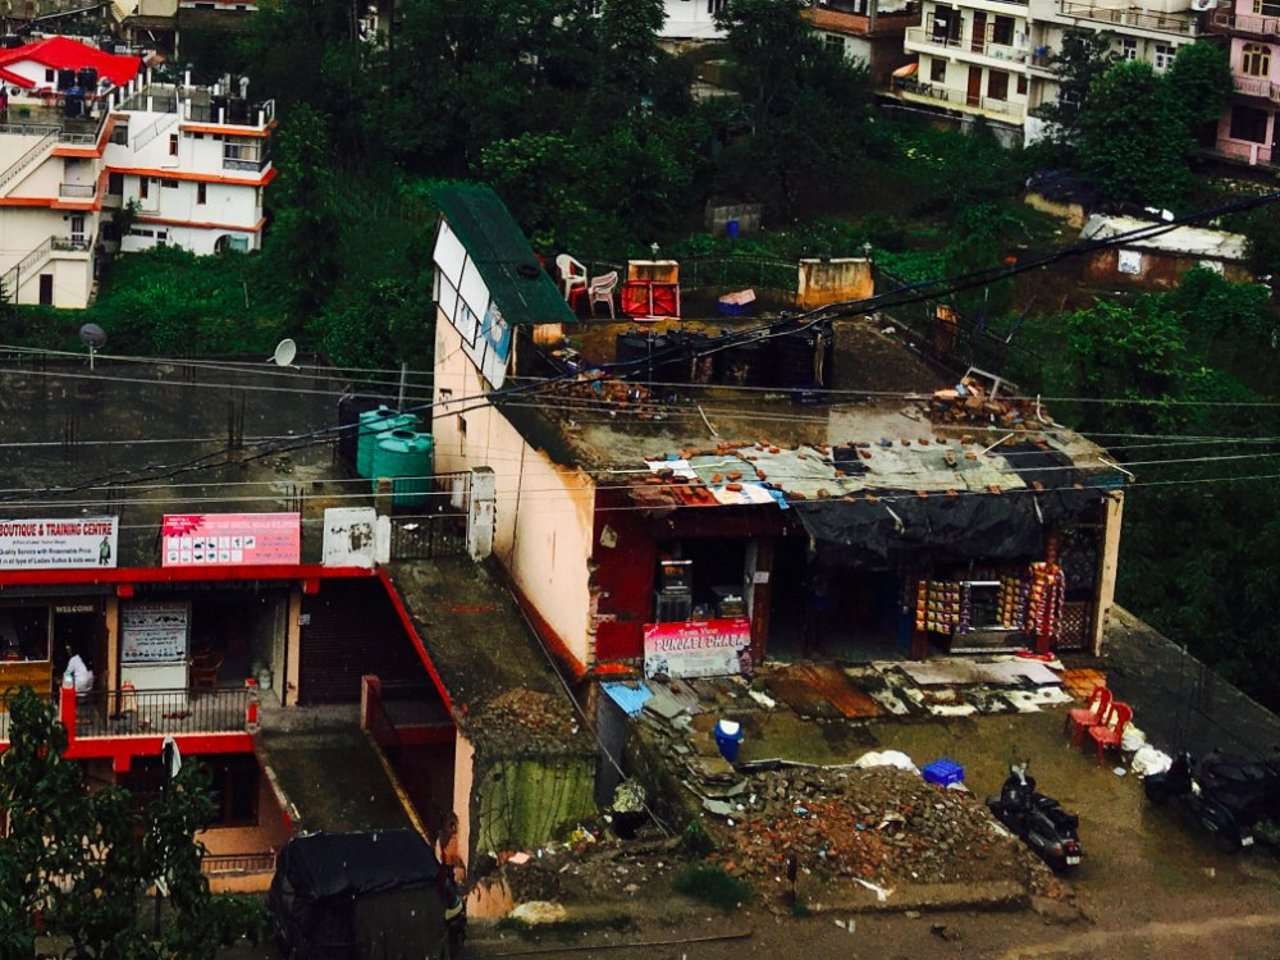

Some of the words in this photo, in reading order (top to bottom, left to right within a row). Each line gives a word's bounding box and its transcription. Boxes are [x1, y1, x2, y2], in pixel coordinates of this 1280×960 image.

[0, 524, 36, 537] BOUTIQUE
[38, 524, 44, 536] &
[46, 523, 81, 536] TRAINING
[83, 522, 112, 535] CENTRE
[0, 548, 16, 556] Quality
[655, 637, 703, 652] PUNJABI
[706, 633, 745, 649] DHABA
